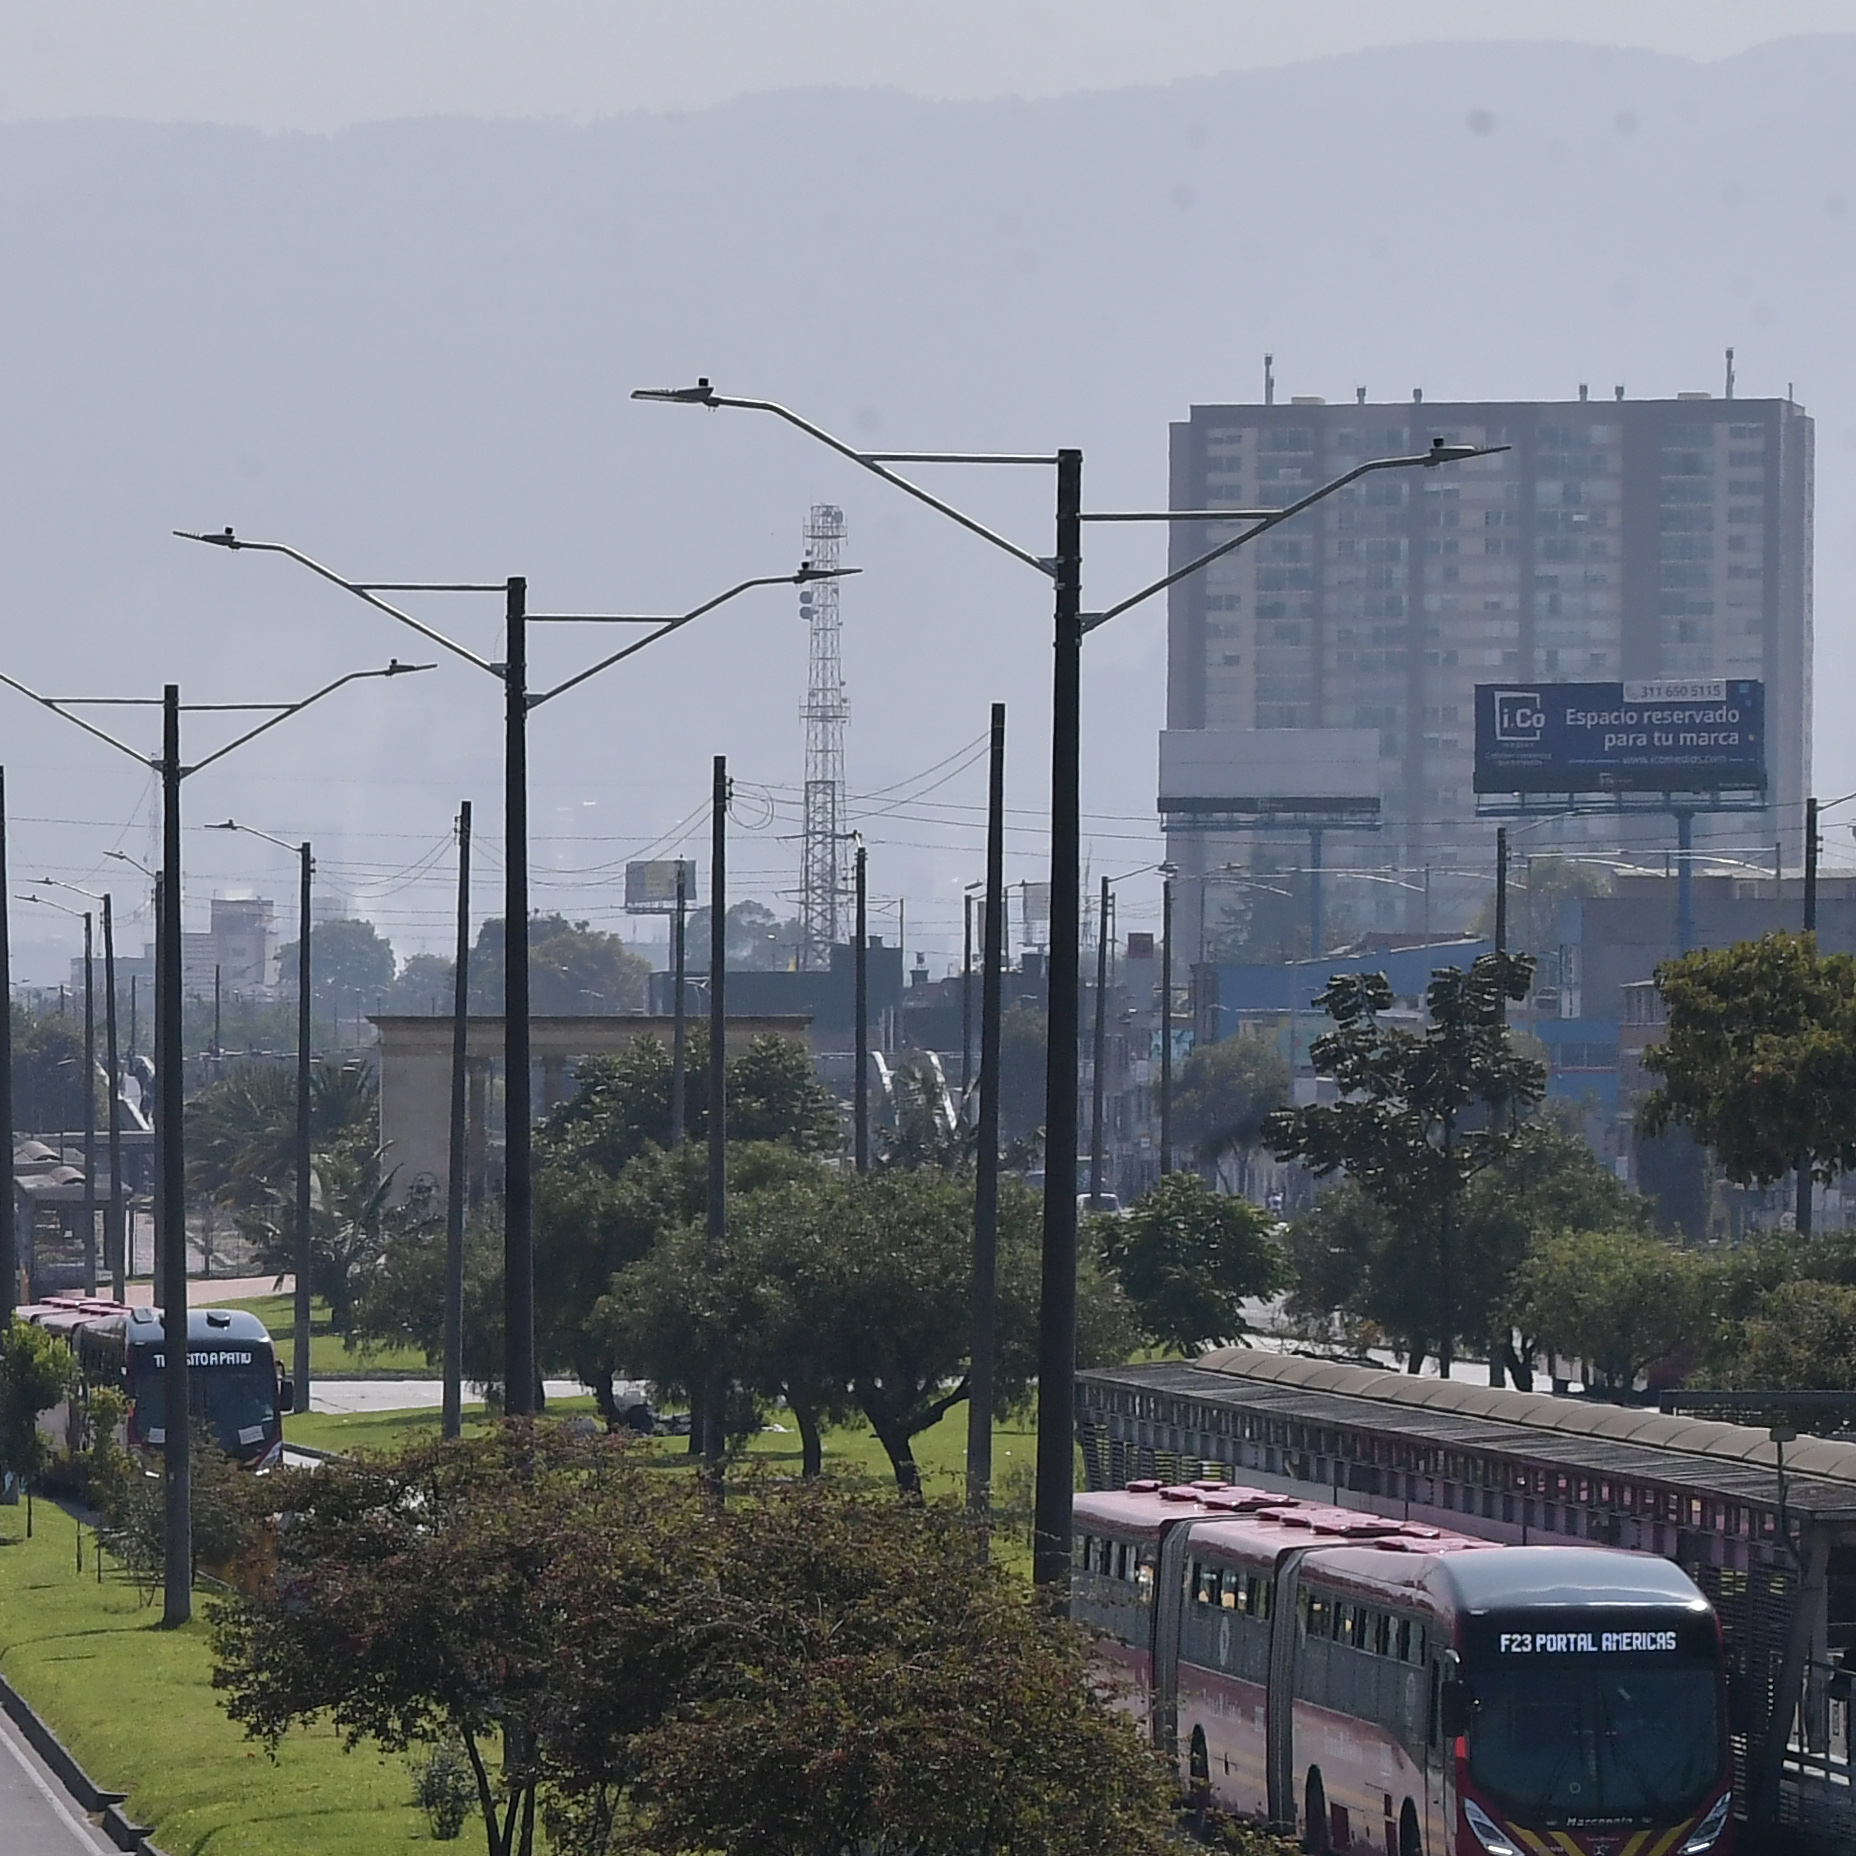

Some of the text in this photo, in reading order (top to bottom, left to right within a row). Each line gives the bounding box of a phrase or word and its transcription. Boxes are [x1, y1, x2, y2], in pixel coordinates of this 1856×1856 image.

[1641, 686, 1721, 697] 311 650 5115
[1566, 706, 1740, 729] Espacio reservado
[1604, 731, 1739, 751] para tu marca
[1500, 1631, 1677, 1652] F23 PORTAL AMERICAS
